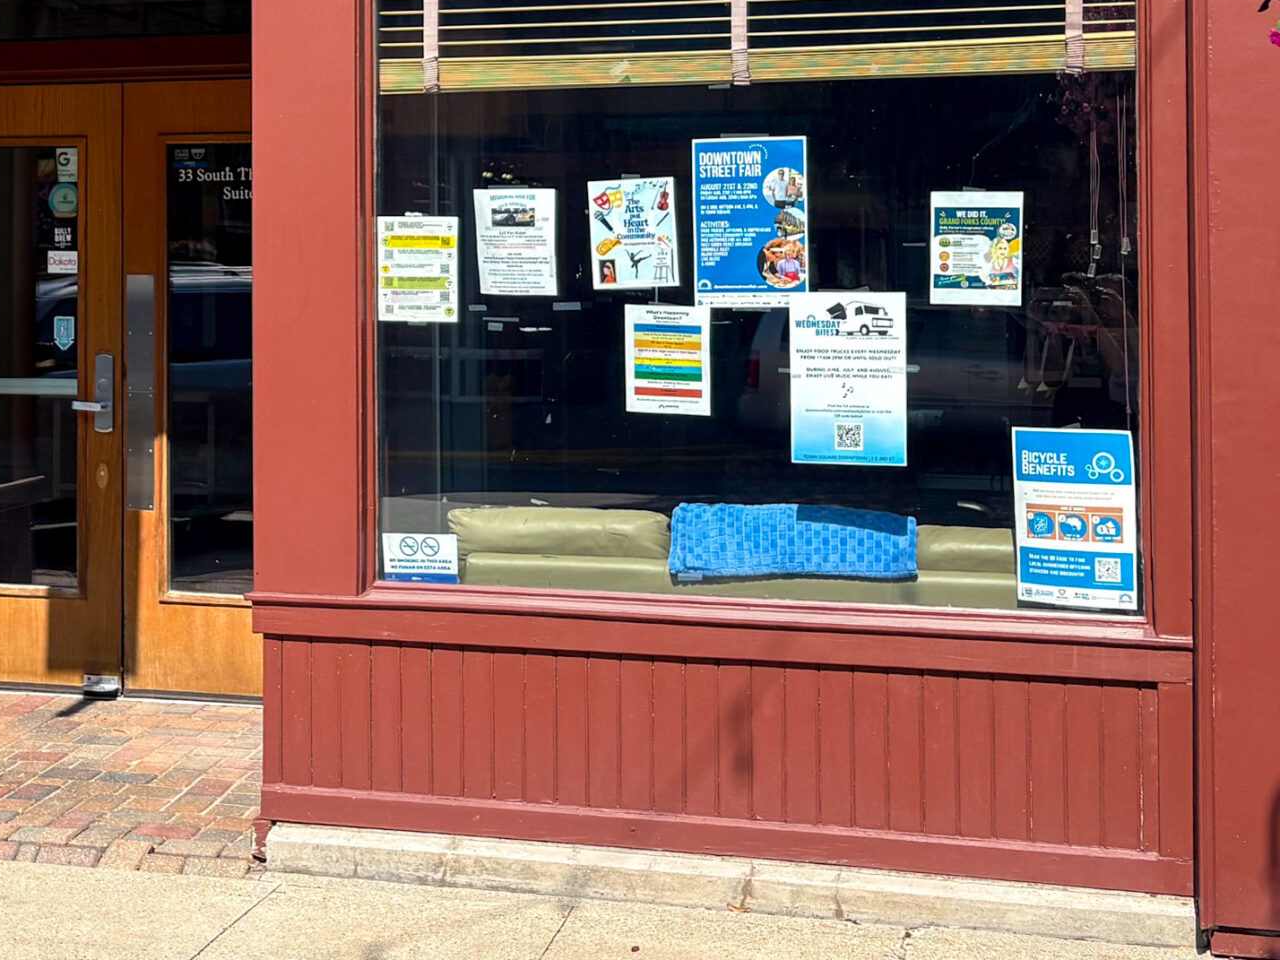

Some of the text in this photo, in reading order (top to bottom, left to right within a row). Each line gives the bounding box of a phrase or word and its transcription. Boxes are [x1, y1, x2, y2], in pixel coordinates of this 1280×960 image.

[700, 151, 761, 165] DOWNTOWN
[179, 169, 192, 181] 33
[197, 167, 233, 181] South
[700, 165, 761, 178] STREET FAIR
[625, 205, 644, 213] Arts
[624, 219, 648, 227] Heart
[617, 232, 655, 240] Community
[48, 257, 76, 265] Dakota
[795, 320, 840, 328] WEDNESDAY
[1022, 450, 1067, 464] BICYCLE
[1022, 463, 1075, 476] BENEFITS
